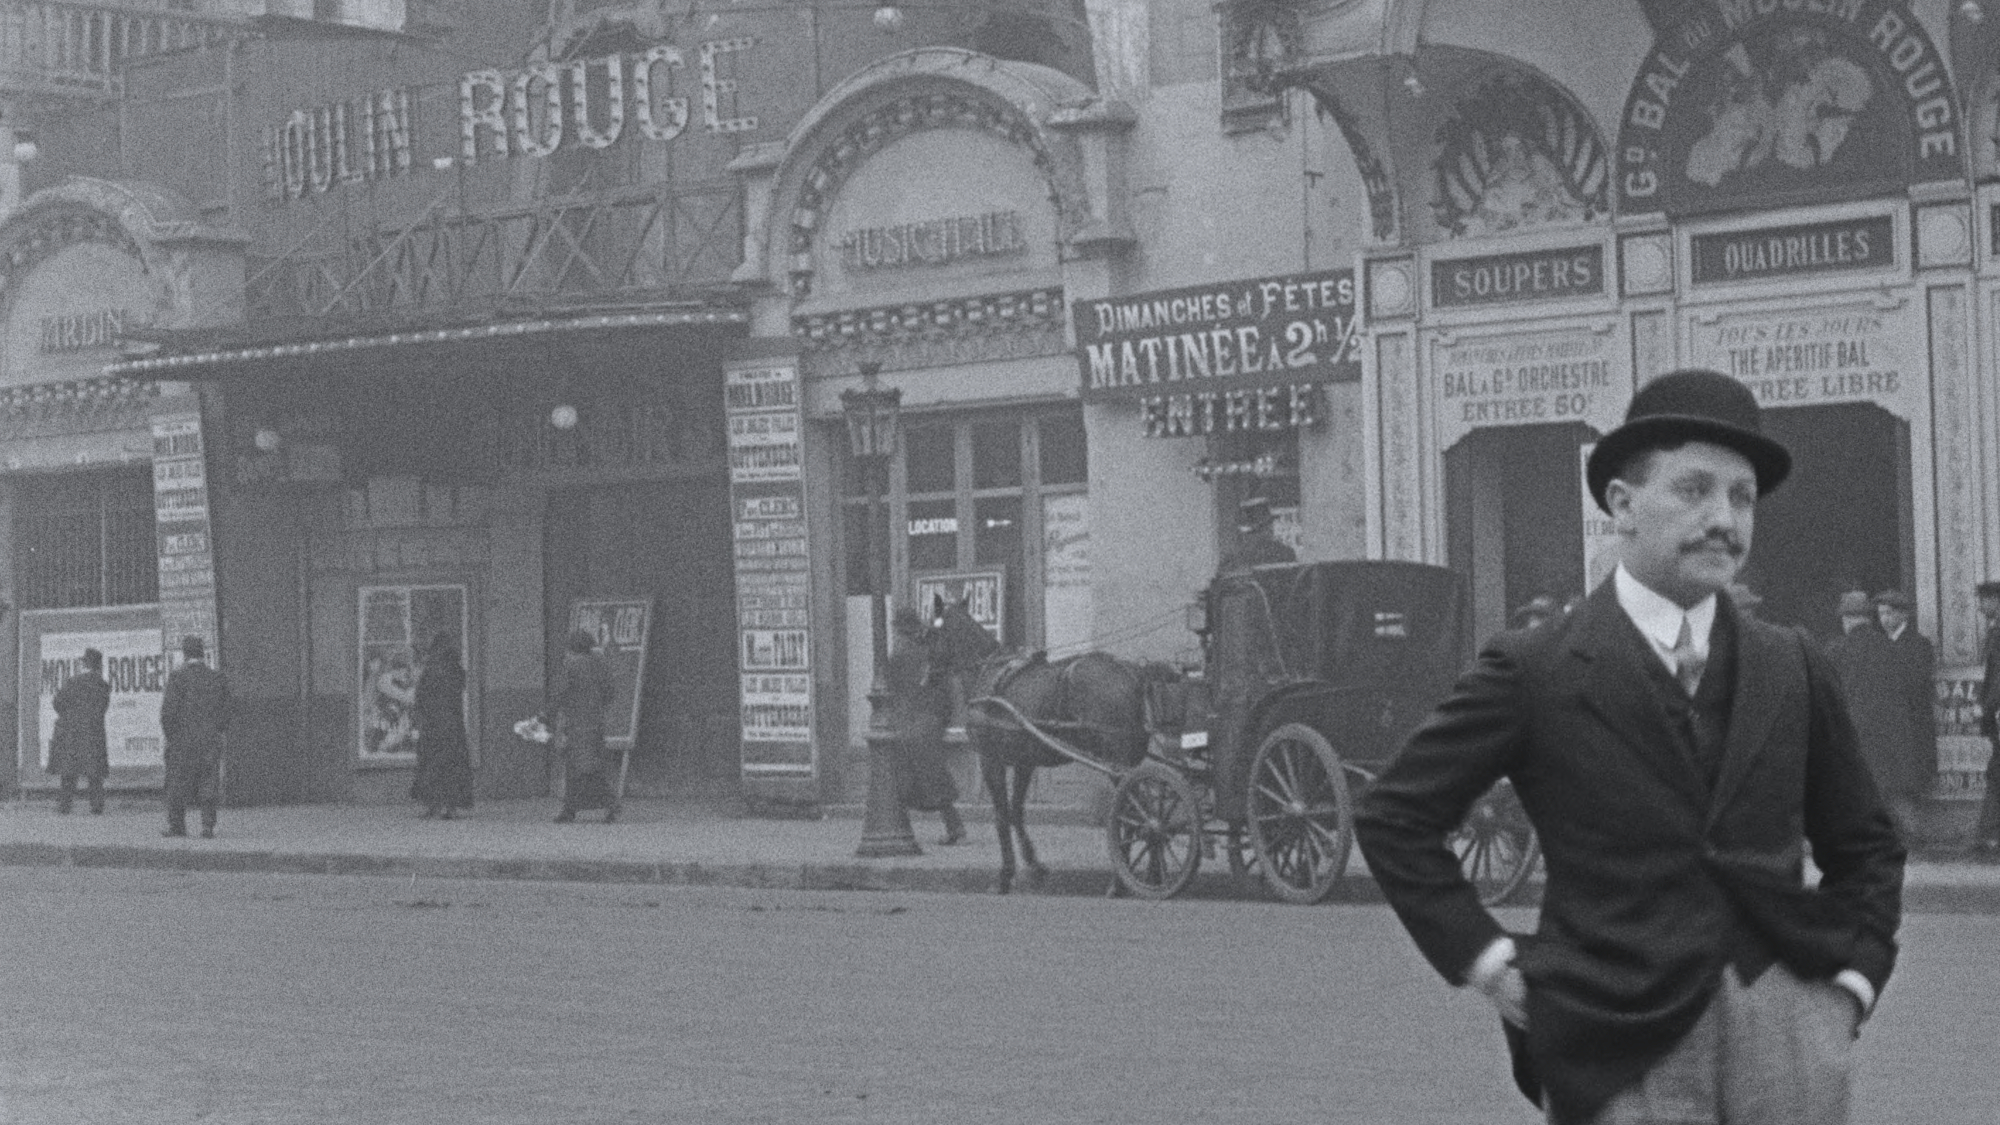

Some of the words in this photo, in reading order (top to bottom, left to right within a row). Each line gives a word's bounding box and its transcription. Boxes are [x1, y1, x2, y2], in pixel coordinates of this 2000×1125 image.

[460, 36, 760, 166] ROUGE
[1632, 51, 1690, 131] BAL
[1869, 10, 1956, 158] ROUGE
[1724, 230, 1870, 276] QUADRILLES
[1455, 257, 1592, 297] SOUPERS
[1095, 293, 1231, 337] DIMANCHES
[1086, 322, 1263, 389] MATINÉE
[1836, 340, 1869, 368] BAL
[1445, 371, 1478, 398] BAL
[1518, 360, 1610, 393] ORCHESTRE
[1752, 378, 1809, 402] REE
[1821, 371, 1900, 396] LIBRE
[908, 518, 957, 534] LOCATION
[108, 655, 164, 693] ROUGE
